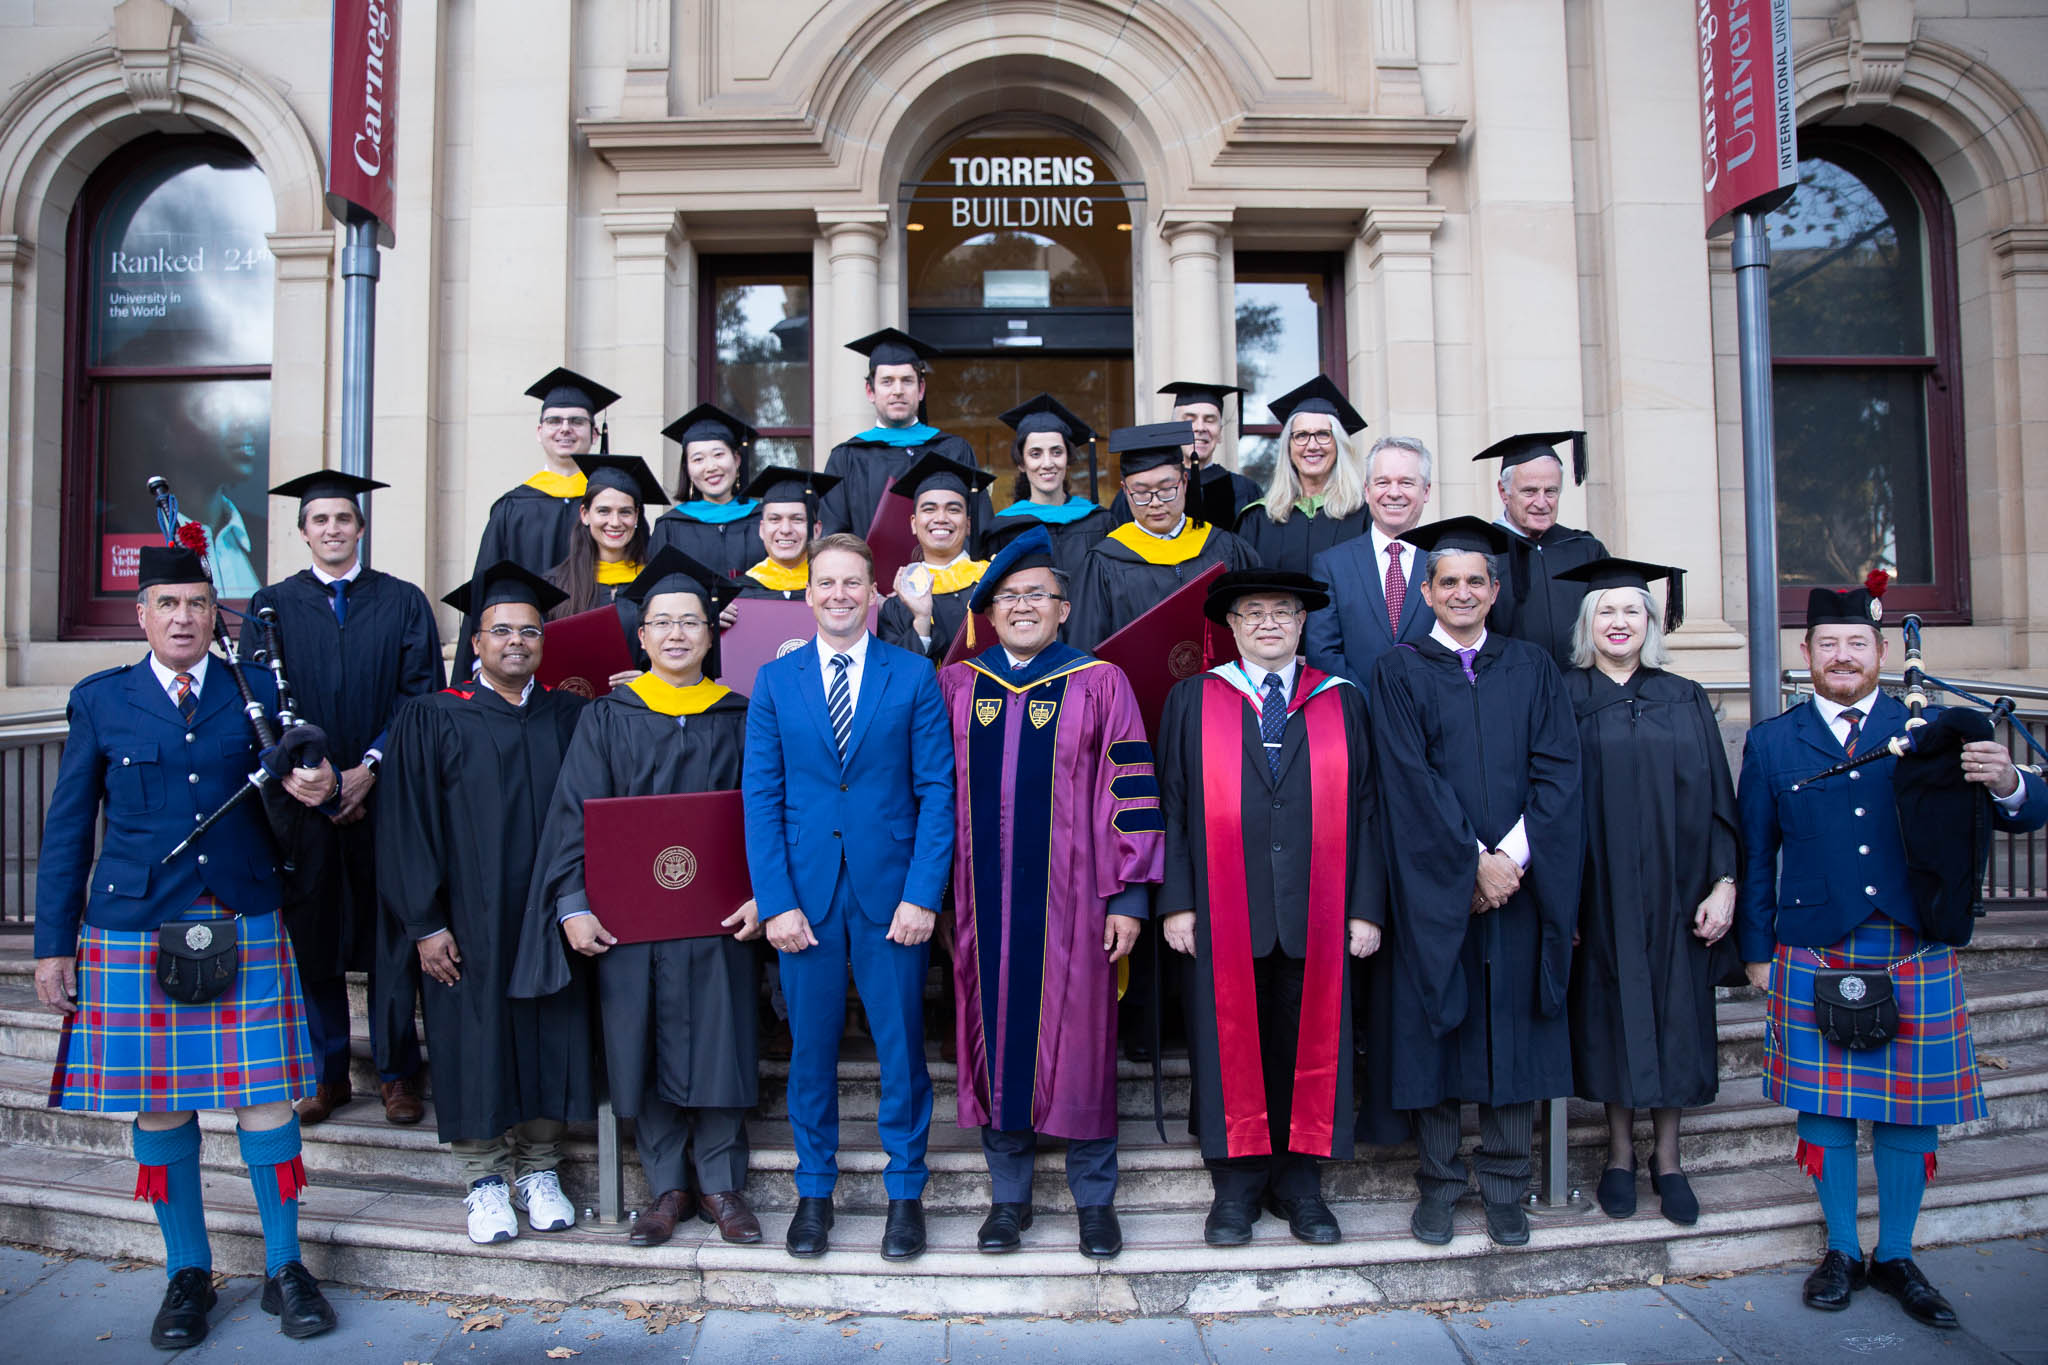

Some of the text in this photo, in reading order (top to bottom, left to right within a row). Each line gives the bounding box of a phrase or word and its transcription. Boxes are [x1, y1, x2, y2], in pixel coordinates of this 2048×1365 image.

[1775, 46, 1793, 171] INTERNATIONAL
[949, 156, 1095, 187] TORRENS
[952, 196, 1094, 228] BUILDING
[111, 247, 204, 274] Ranked
[109, 291, 182, 306] University in
[109, 306, 167, 318] the World
